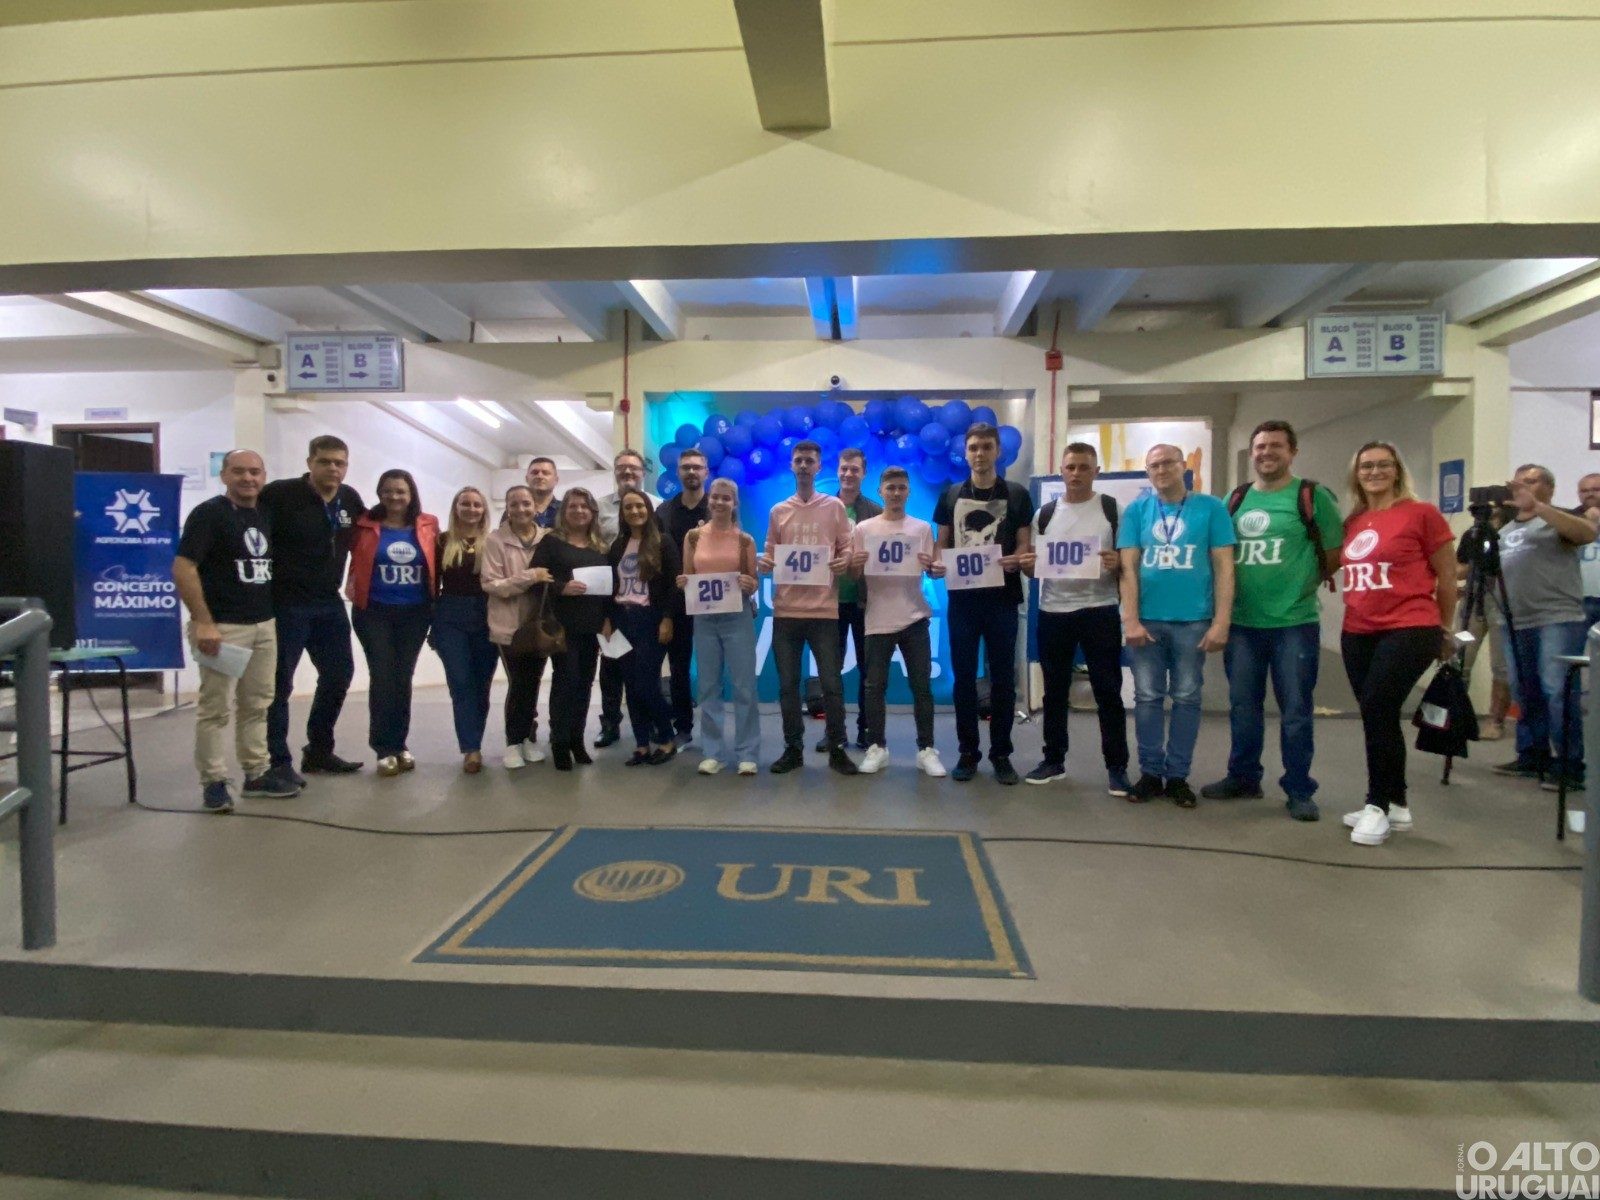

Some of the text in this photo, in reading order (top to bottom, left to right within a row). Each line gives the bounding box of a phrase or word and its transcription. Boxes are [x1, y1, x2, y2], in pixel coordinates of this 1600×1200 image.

[1321, 325, 1350, 333] BLOCO
[1327, 336, 1343, 351] A
[1390, 335, 1405, 350] B
[301, 354, 314, 368] A
[354, 353, 367, 368] B
[234, 559, 272, 583] UR
[379, 564, 422, 585] URI
[93, 581, 175, 592] CONCEITO
[94, 593, 176, 608] MÁXIMO
[716, 863, 930, 906] URI
